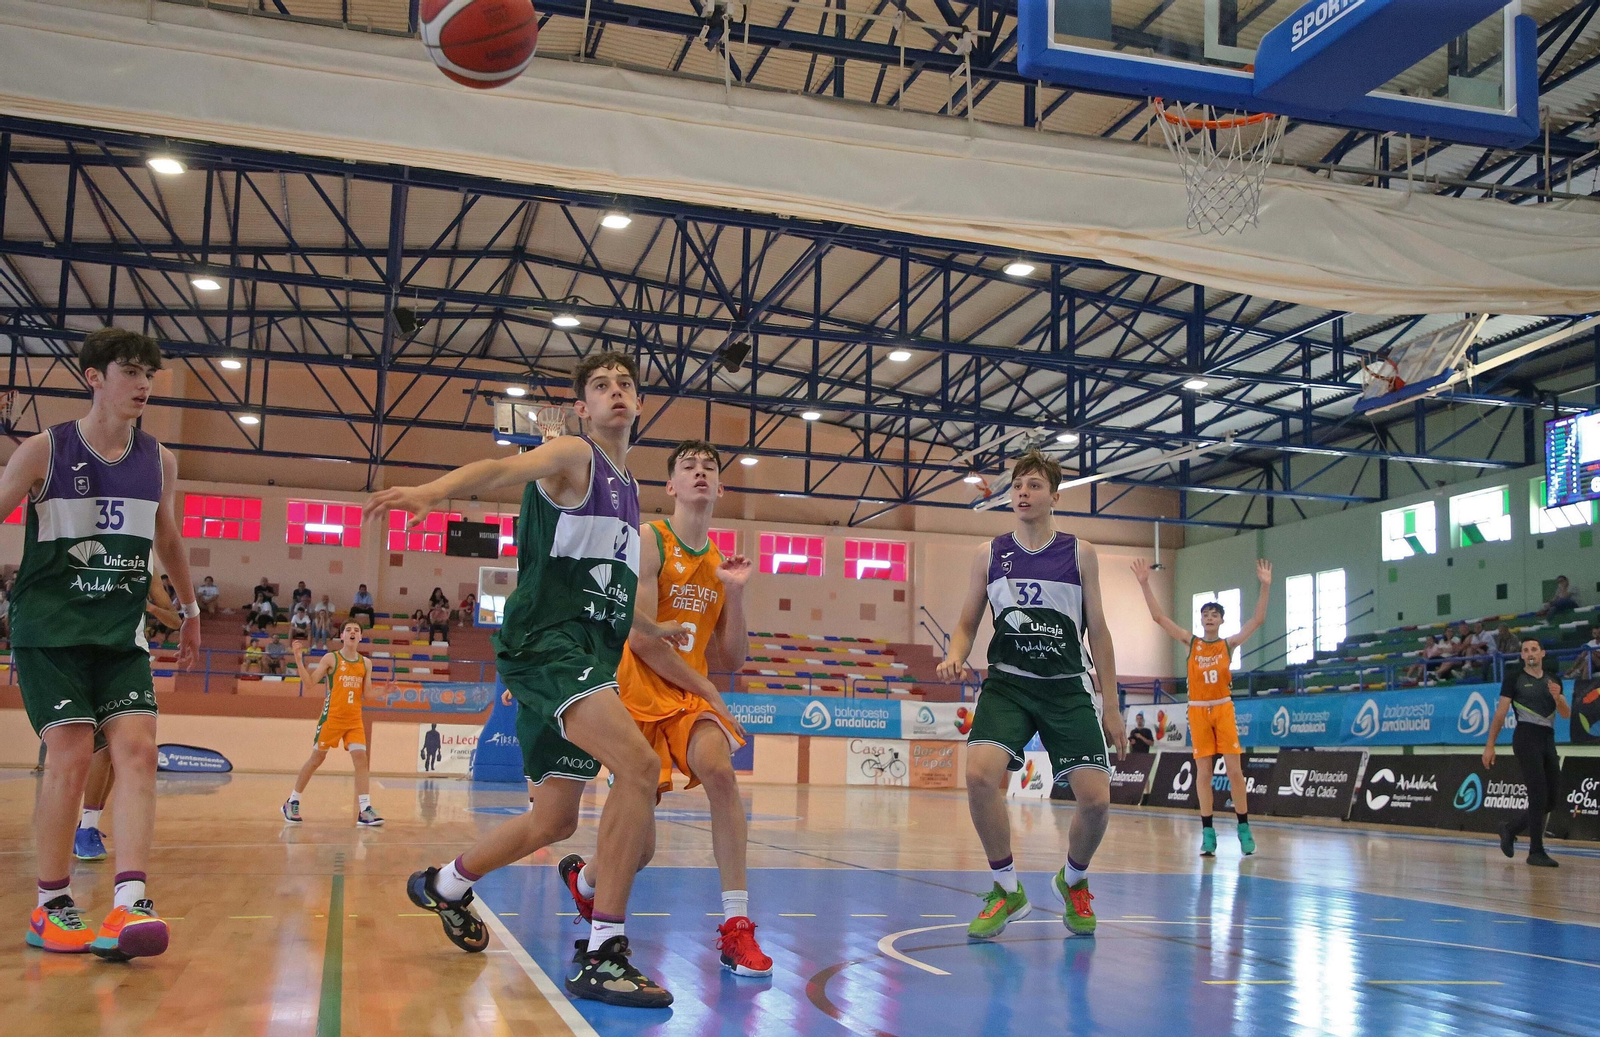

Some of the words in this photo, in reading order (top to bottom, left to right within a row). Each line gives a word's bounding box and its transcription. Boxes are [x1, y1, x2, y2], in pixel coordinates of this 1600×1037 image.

[1291, 0, 1351, 43] SPORT
[96, 500, 125, 530] 35
[103, 554, 146, 569] Unicaja
[1015, 582, 1044, 606] 32
[672, 597, 708, 614] GREEN
[1030, 622, 1064, 636] Unicaja
[1202, 669, 1218, 684] 18
[347, 690, 355, 704] 2
[377, 685, 467, 707] portes
[834, 706, 889, 719] baloncesto
[1291, 709, 1331, 723] baloncesto
[1383, 702, 1435, 719] baloncesto
[441, 735, 454, 745] La
[850, 739, 886, 756] Casa
[913, 744, 936, 757] Bar
[939, 745, 954, 757] de
[169, 753, 225, 764] Ayuntamiento
[914, 755, 954, 770] Tapas
[1113, 770, 1145, 783] baloncesto
[1308, 769, 1348, 783] Diputación
[1167, 789, 1190, 801] urbaser
[1305, 787, 1316, 798] de
[1316, 786, 1338, 799] Cádiz
